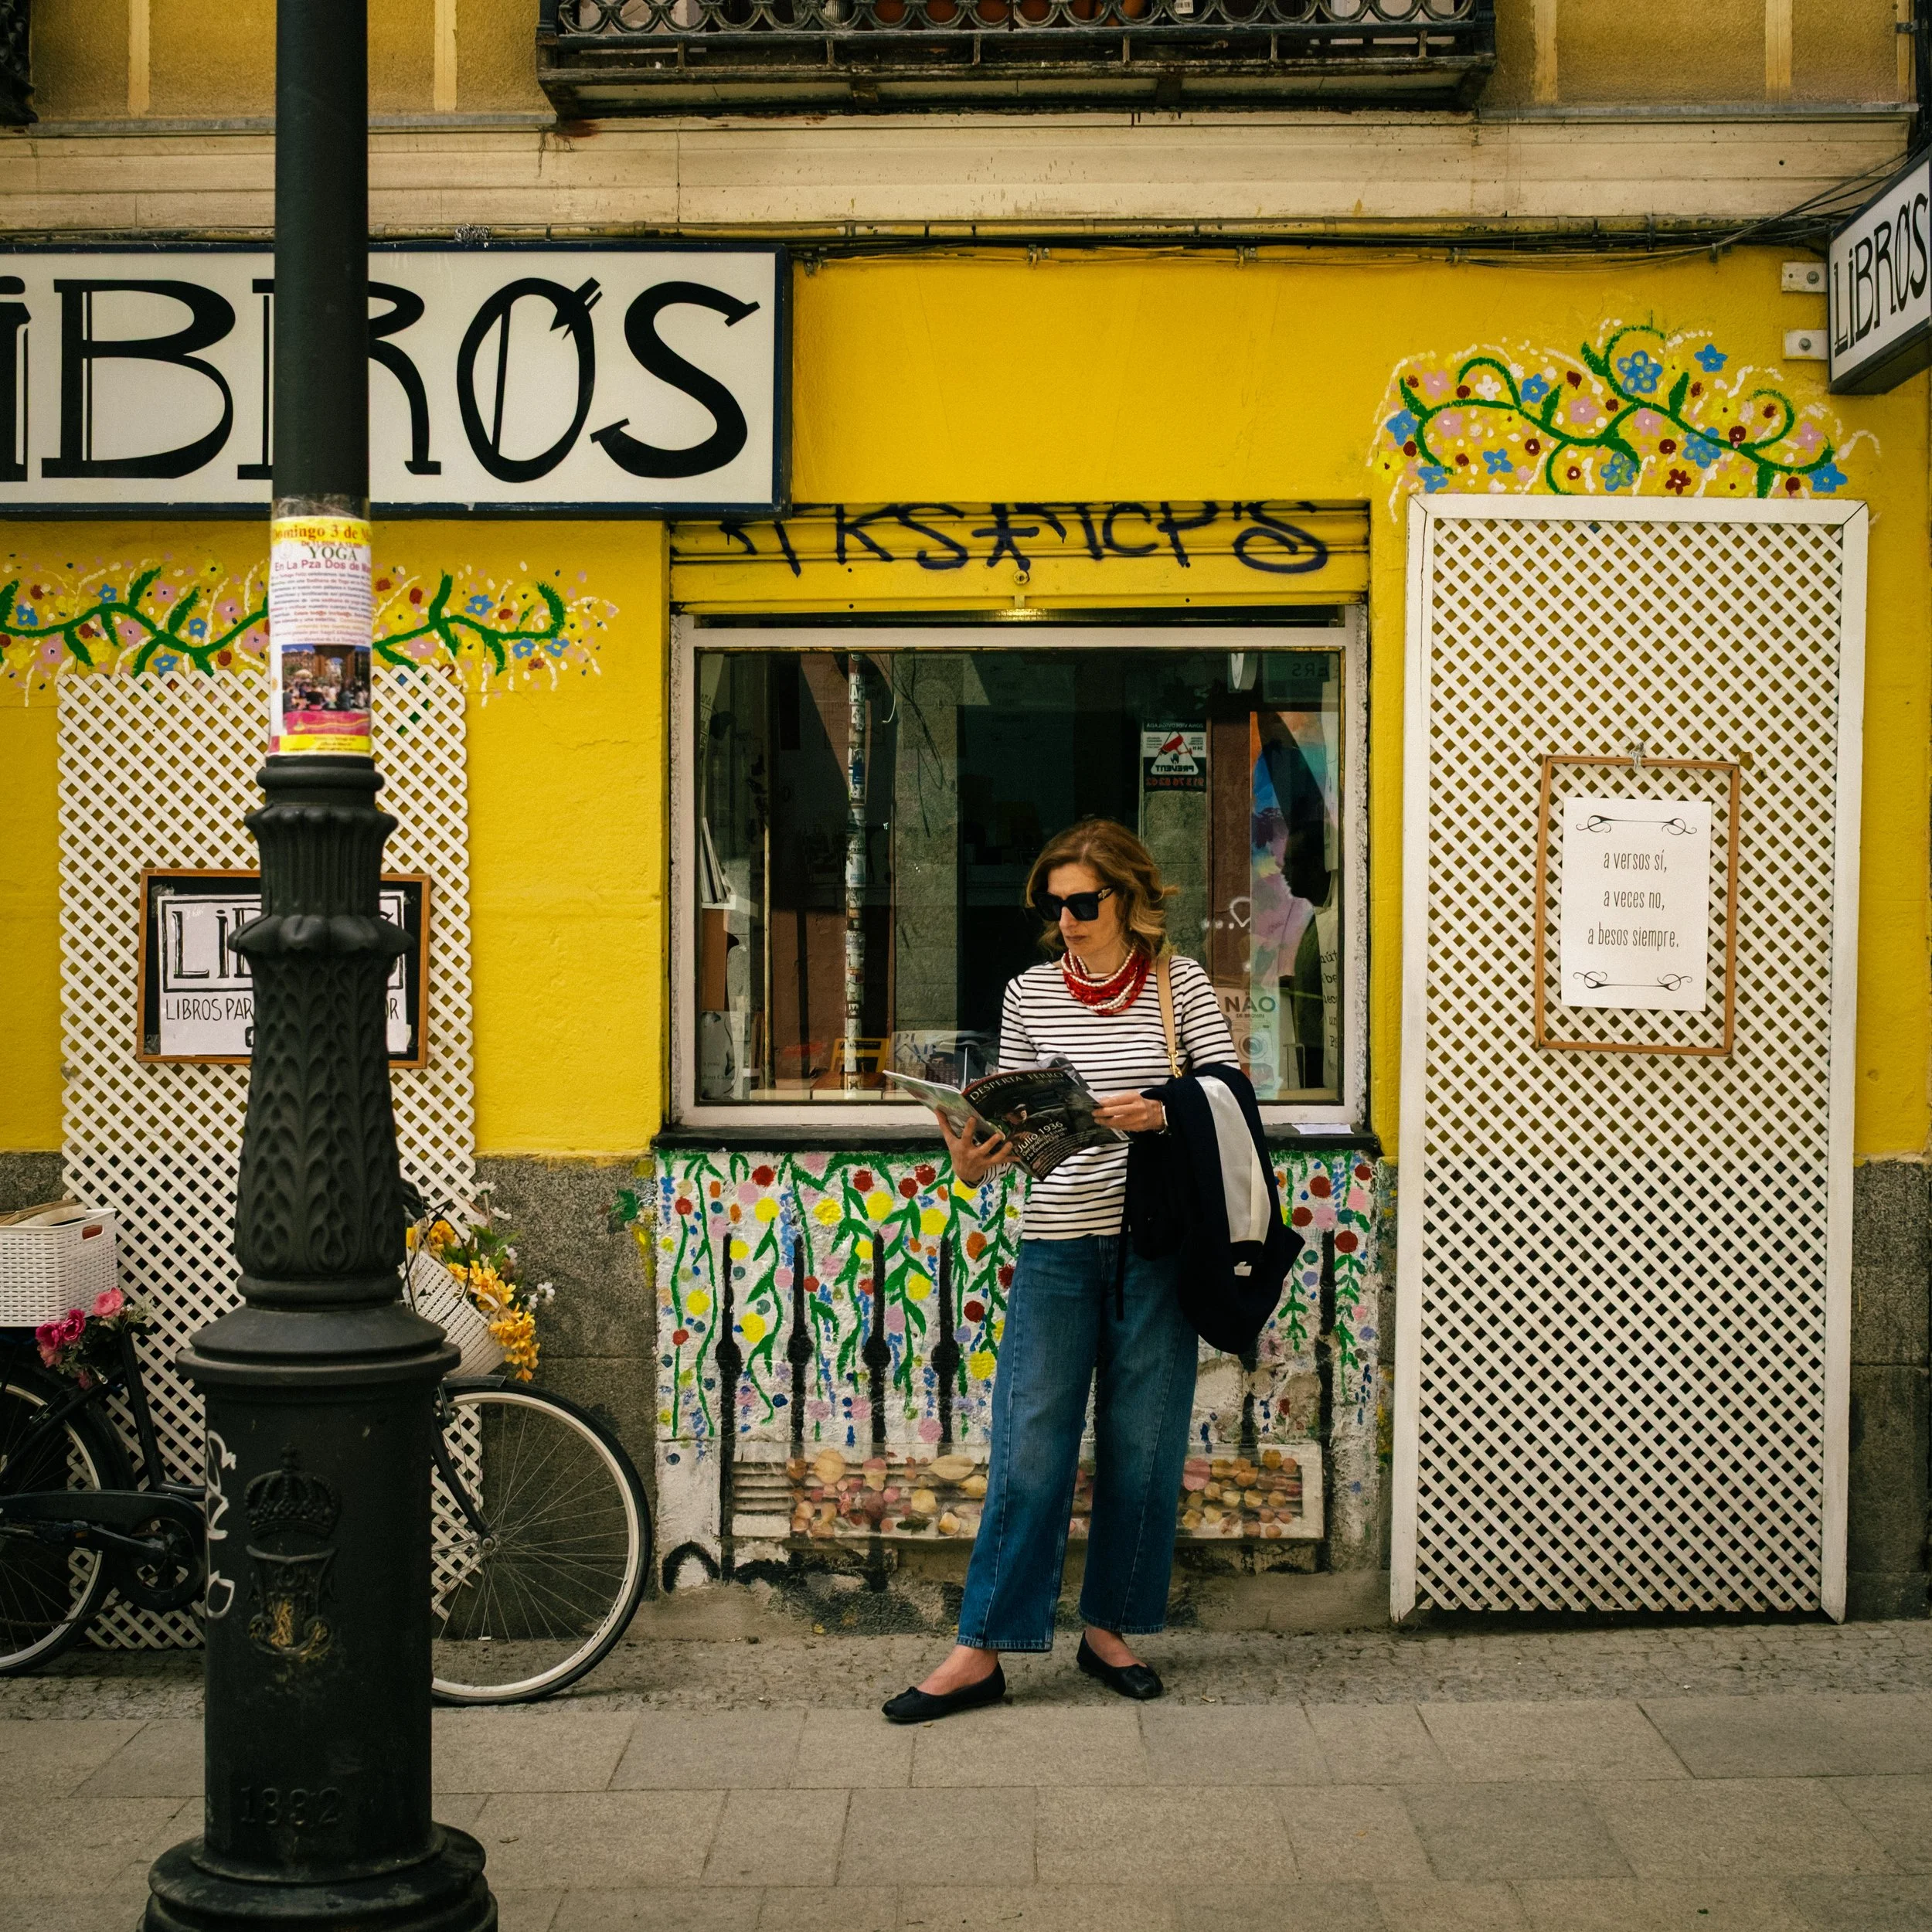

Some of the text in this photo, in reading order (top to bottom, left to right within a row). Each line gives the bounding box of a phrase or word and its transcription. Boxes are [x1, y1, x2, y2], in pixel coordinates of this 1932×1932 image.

[331, 525, 339, 538] 3
[344, 526, 359, 539] de
[309, 546, 358, 562] YOGA
[274, 563, 284, 572] En
[287, 561, 298, 570] La
[301, 560, 321, 569] Pza
[325, 560, 346, 570] Dos
[1603, 849, 1668, 872] a versos sí,
[1603, 890, 1665, 911] a veces no,
[1587, 922, 1680, 951] a besos siempre.
[165, 998, 223, 1021] LIBROS
[968, 1074, 1024, 1102] DESPERTA
[1016, 1121, 1063, 1153] Julio 1936
